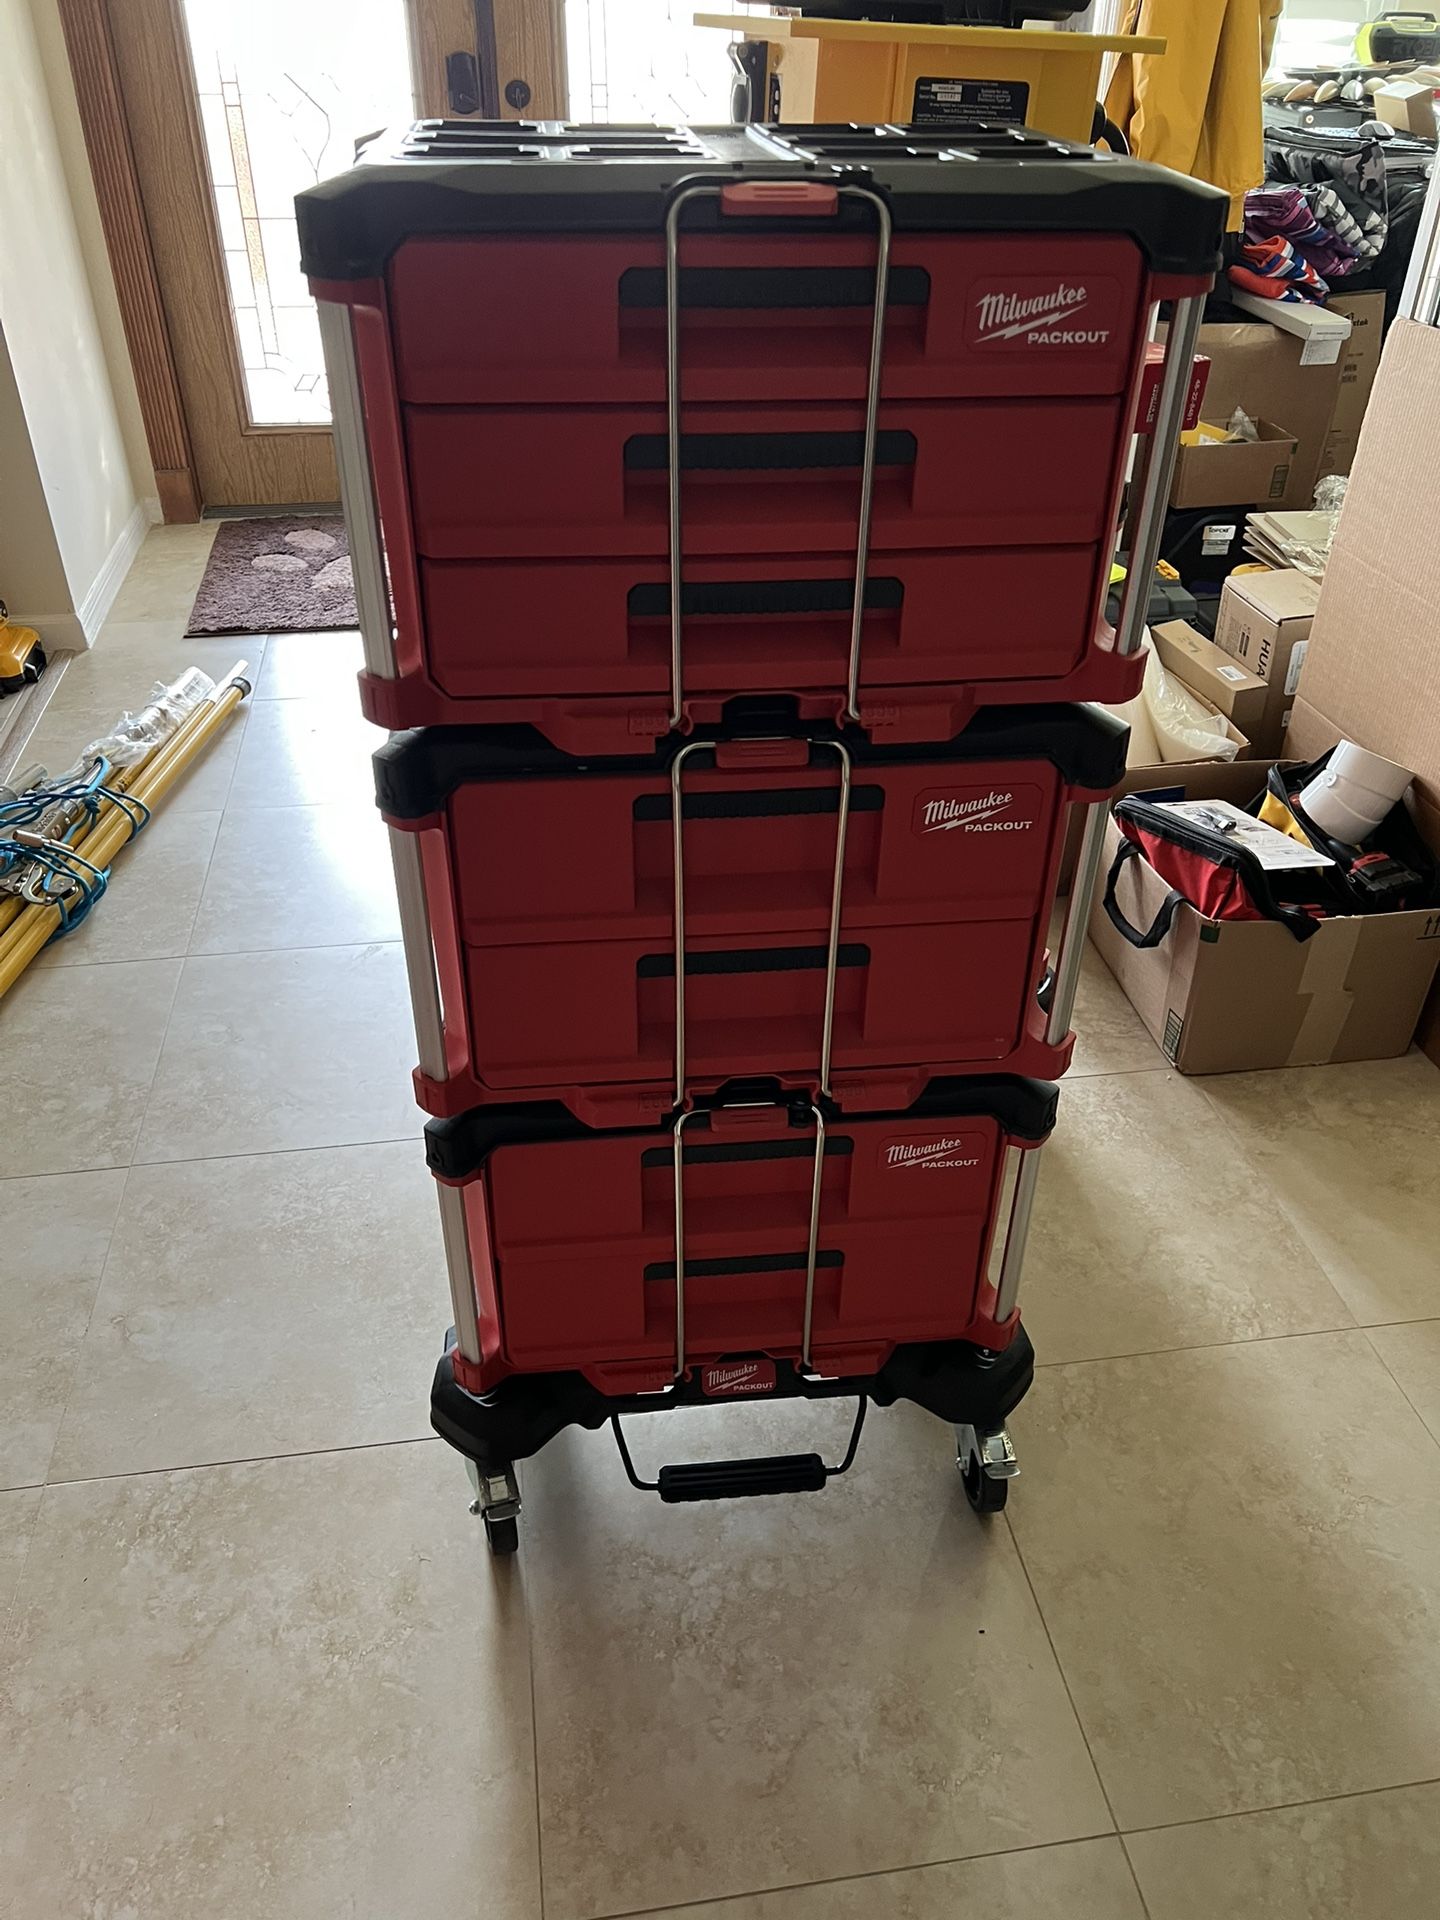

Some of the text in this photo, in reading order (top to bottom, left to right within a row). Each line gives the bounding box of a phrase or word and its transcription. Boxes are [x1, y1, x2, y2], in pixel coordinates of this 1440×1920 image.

[976, 283, 1088, 331] Milwaukee
[1027, 330, 1110, 345] PACKOUT
[921, 791, 1014, 825] Milwaukee
[964, 821, 1033, 833] PACKOUT
[884, 1138, 962, 1164] Milwaukee
[922, 1159, 980, 1169] PACKOUT
[706, 1363, 758, 1387] Milwaukee
[733, 1382, 774, 1391] PACKOUT
